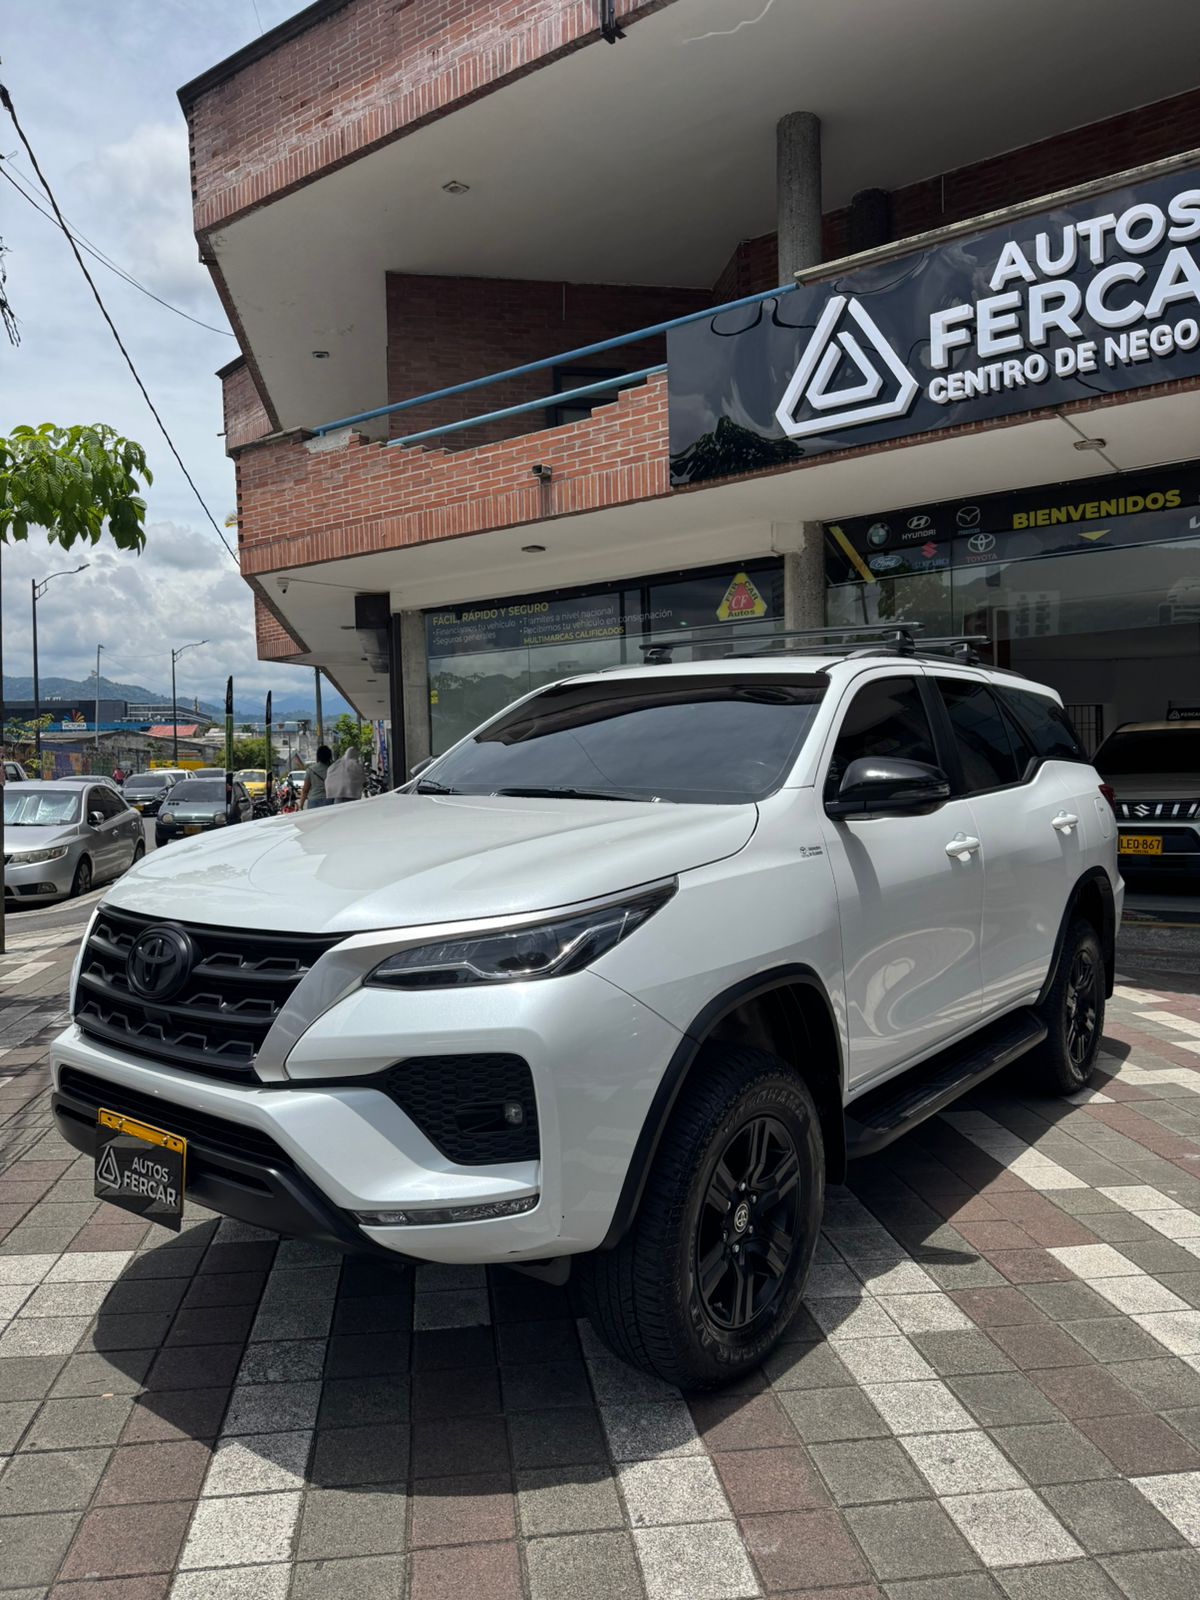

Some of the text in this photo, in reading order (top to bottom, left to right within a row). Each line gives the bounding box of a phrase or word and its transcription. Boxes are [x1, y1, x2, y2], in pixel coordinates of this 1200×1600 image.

[990, 189, 1200, 291] AUTOS
[928, 318, 1200, 404] CENTRO DE NEGO
[1012, 489, 1182, 529] BIENVENIDOS
[902, 529, 937, 540] HYUNDAI
[966, 552, 998, 563] TOYOTA
[500, 607, 507, 617] Y
[508, 602, 549, 616] SEGURO
[605, 617, 616, 625] en
[617, 608, 673, 623] consignación
[728, 609, 756, 617] Autos
[523, 626, 625, 645] MULTIMARCAS CALIFICADOS
[131, 1156, 169, 1182] AUTOS
[123, 1171, 177, 1207] FERCAR
